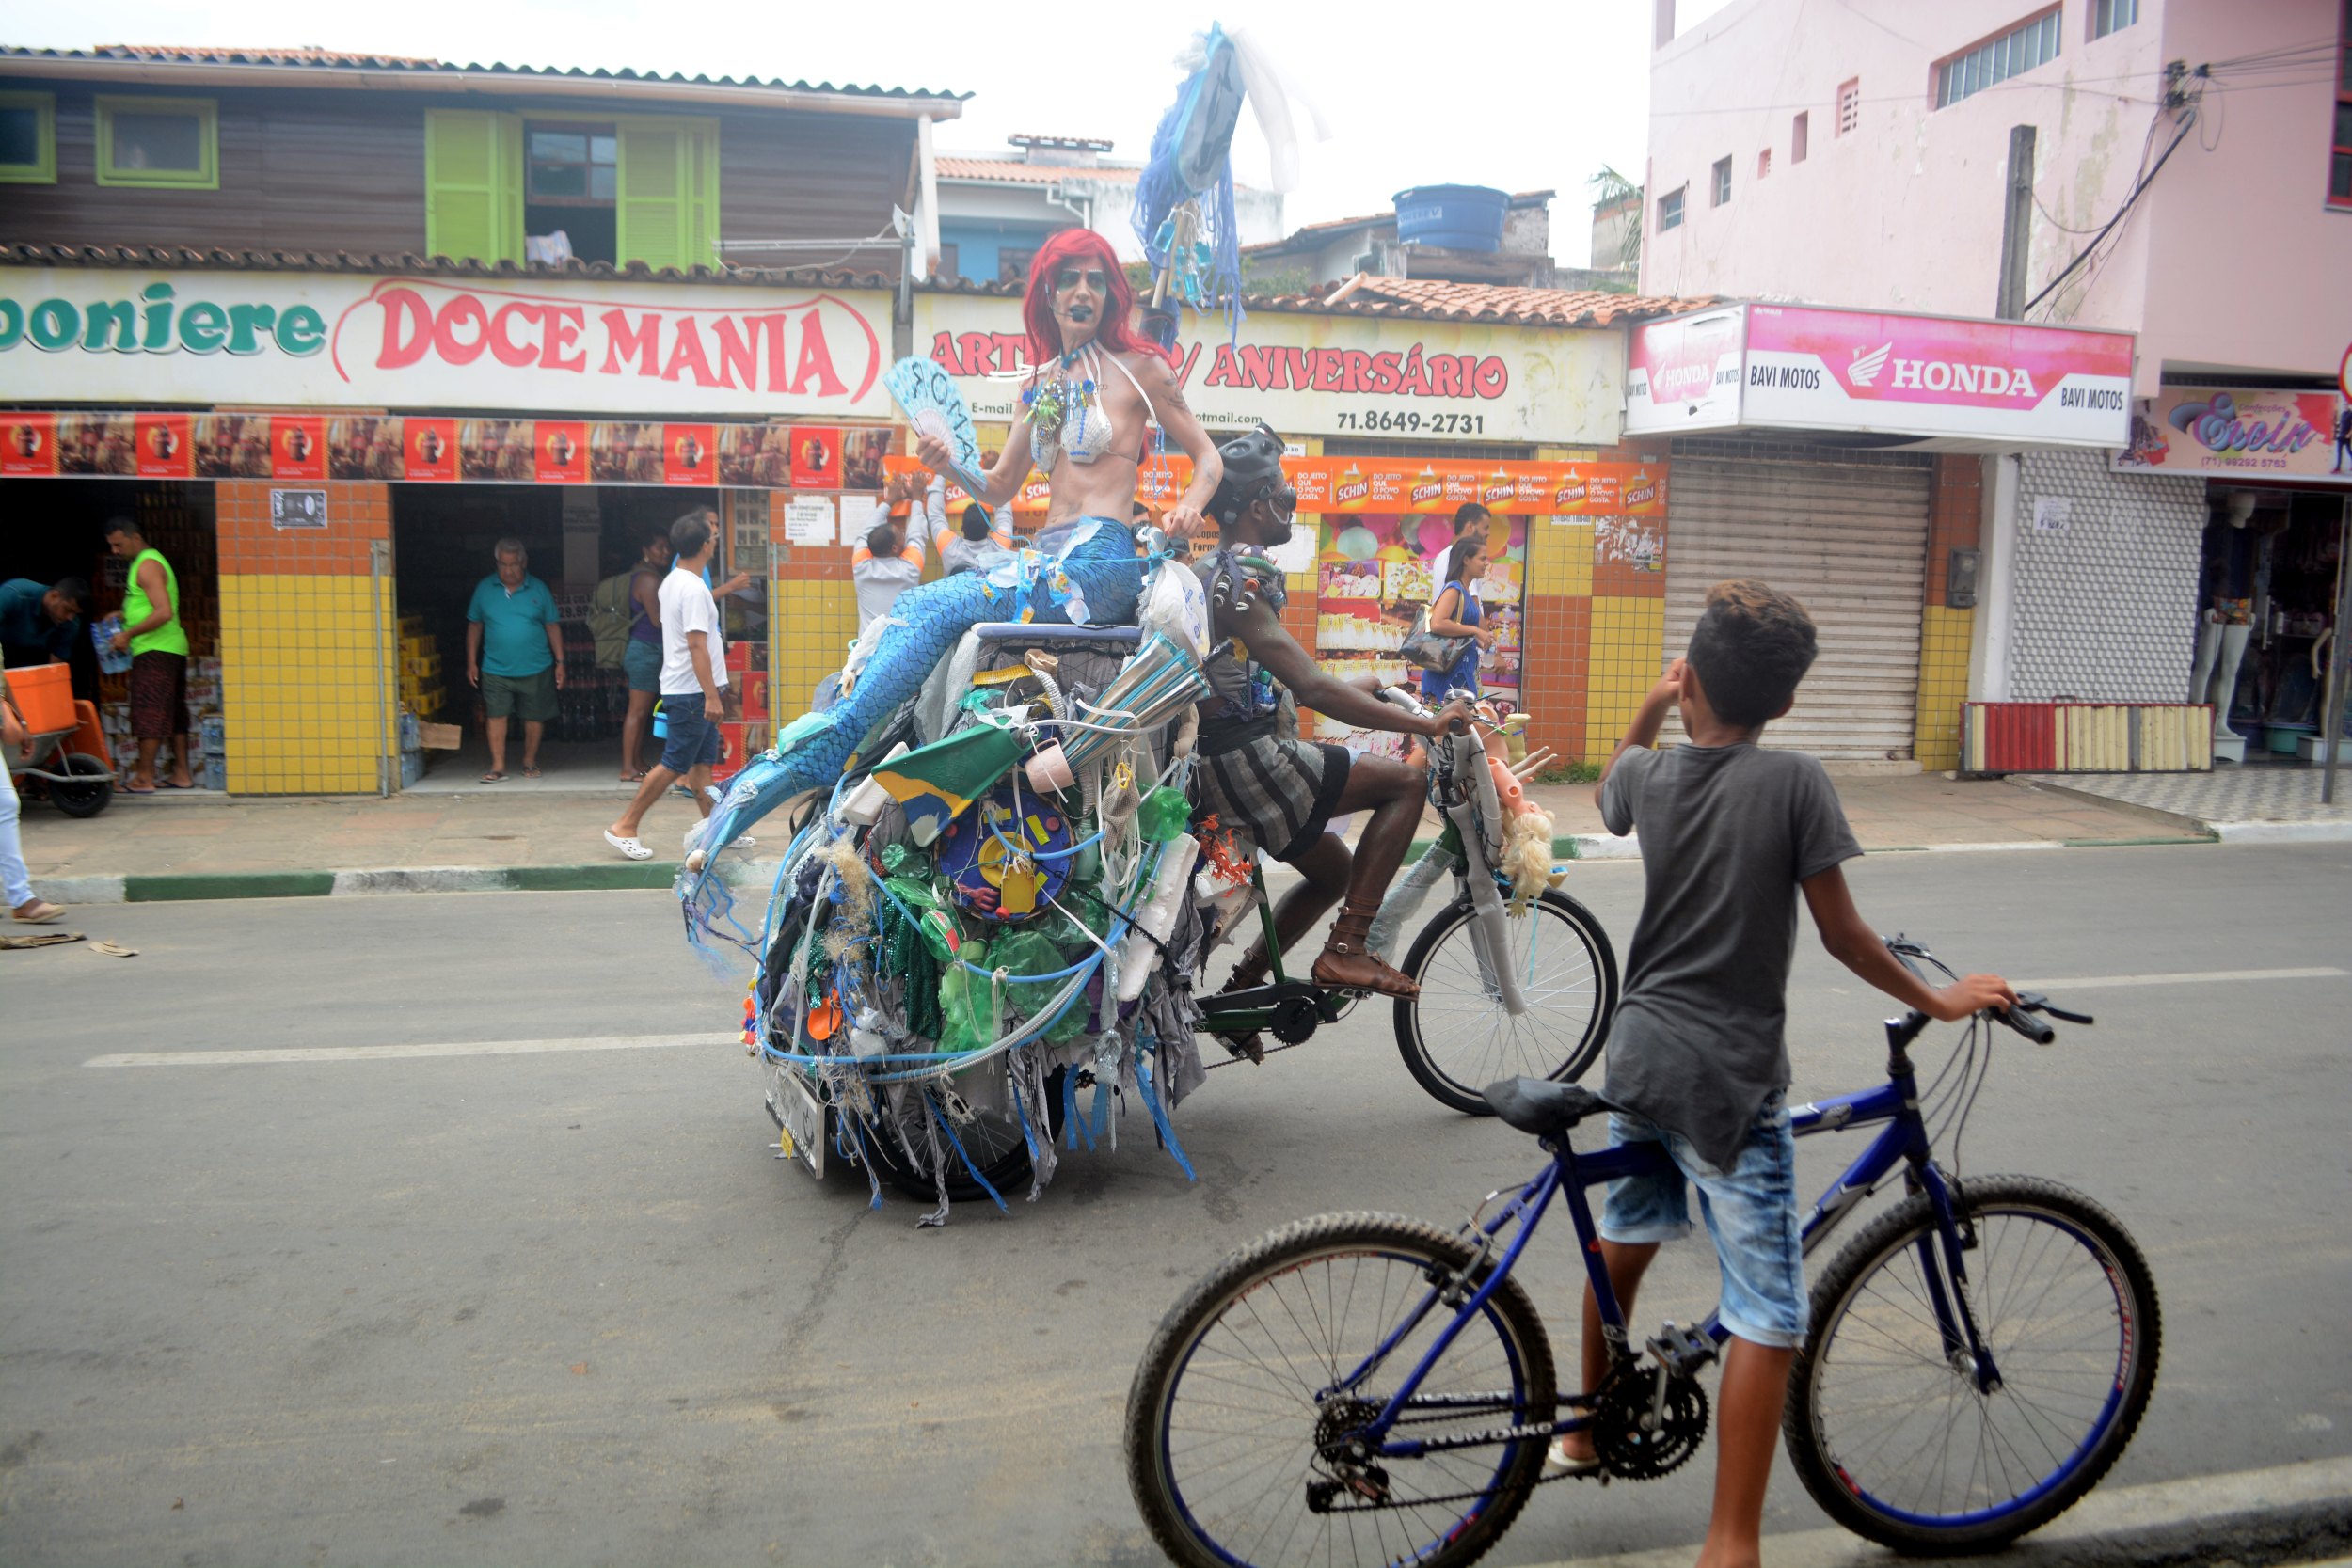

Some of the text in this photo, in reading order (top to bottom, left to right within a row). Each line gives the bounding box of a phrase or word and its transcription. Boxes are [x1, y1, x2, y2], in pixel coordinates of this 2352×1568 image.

[376, 288, 850, 397] DOCE MANIA
[1204, 342, 1508, 400] ANIVERSÁRIO
[1665, 364, 1710, 388] HONDA
[1750, 365, 1820, 390] BAVI MOTOS
[1892, 358, 2038, 398] HONDA
[2060, 387, 2123, 411] BAVI MOTOS
[1195, 412, 1263, 423] otmail.com
[1337, 411, 1484, 435] 71.8649-2731
[1026, 483, 1050, 499] SCHI
[1338, 483, 1367, 501] SCHIN
[1412, 483, 1441, 501] SCHIN
[1485, 484, 1514, 502] SCHIN
[1557, 485, 1585, 503] SCHIN
[1627, 486, 1654, 505] SCHIN
